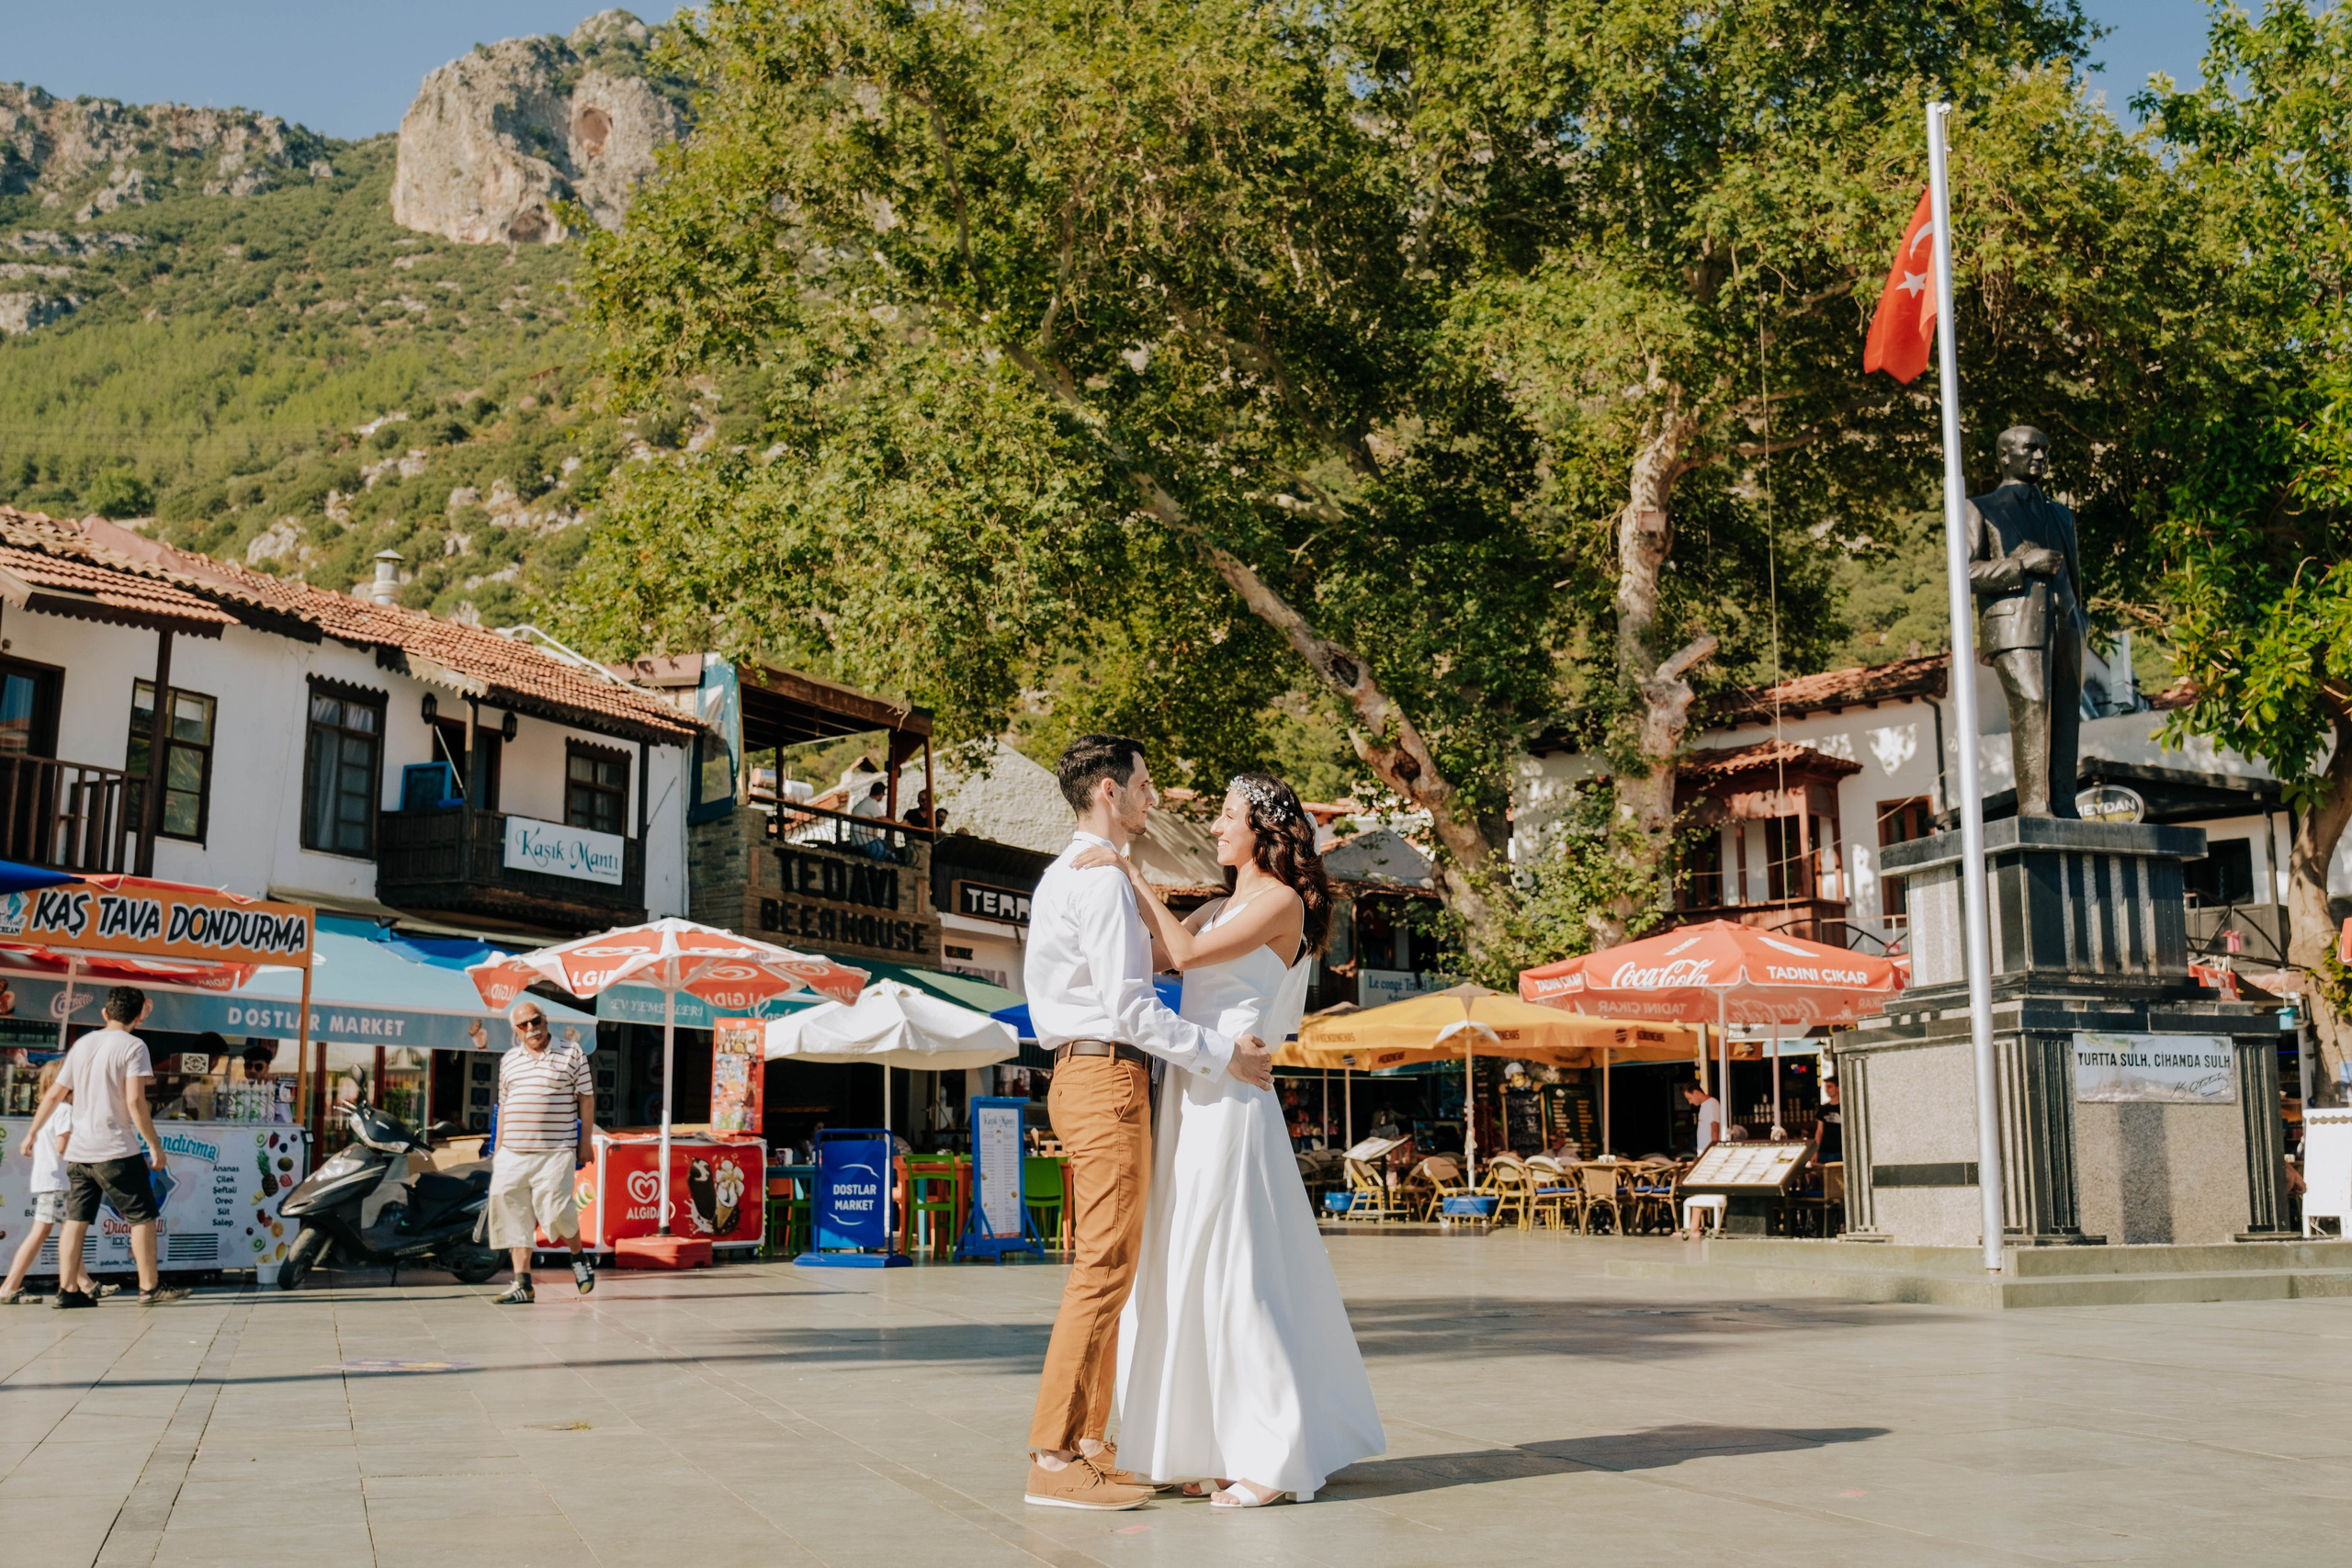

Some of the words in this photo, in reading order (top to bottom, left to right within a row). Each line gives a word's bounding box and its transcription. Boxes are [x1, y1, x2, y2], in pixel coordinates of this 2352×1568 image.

[515, 827, 564, 868] Kaşık
[571, 840, 618, 873] Mantı
[967, 887, 1032, 920] TERR
[33, 892, 91, 935] KAŞ
[98, 897, 160, 938] TAVA
[167, 905, 306, 953] DONDURMA
[1767, 965, 1818, 982] TADINI
[1821, 968, 1868, 985] ÇIKAR
[51, 990, 94, 1018] Conetto
[631, 999, 704, 1017] YEMELERİ
[329, 1015, 405, 1037] MARKET
[2078, 1053, 2117, 1066] YURTTA
[2120, 1054, 2151, 1068] SULH,
[2154, 1051, 2200, 1067] CİHANDA
[2204, 1055, 2231, 1068] SULH
[138, 1134, 218, 1161] ndurma
[216, 1175, 235, 1184] Çilek
[212, 1186, 238, 1195] Şeftali
[833, 1184, 876, 1195] DOSTLAR
[834, 1200, 875, 1211] MARKET
[103, 1218, 132, 1235] Dud
[212, 1218, 234, 1227] Salep
[112, 1237, 127, 1246] ICE
